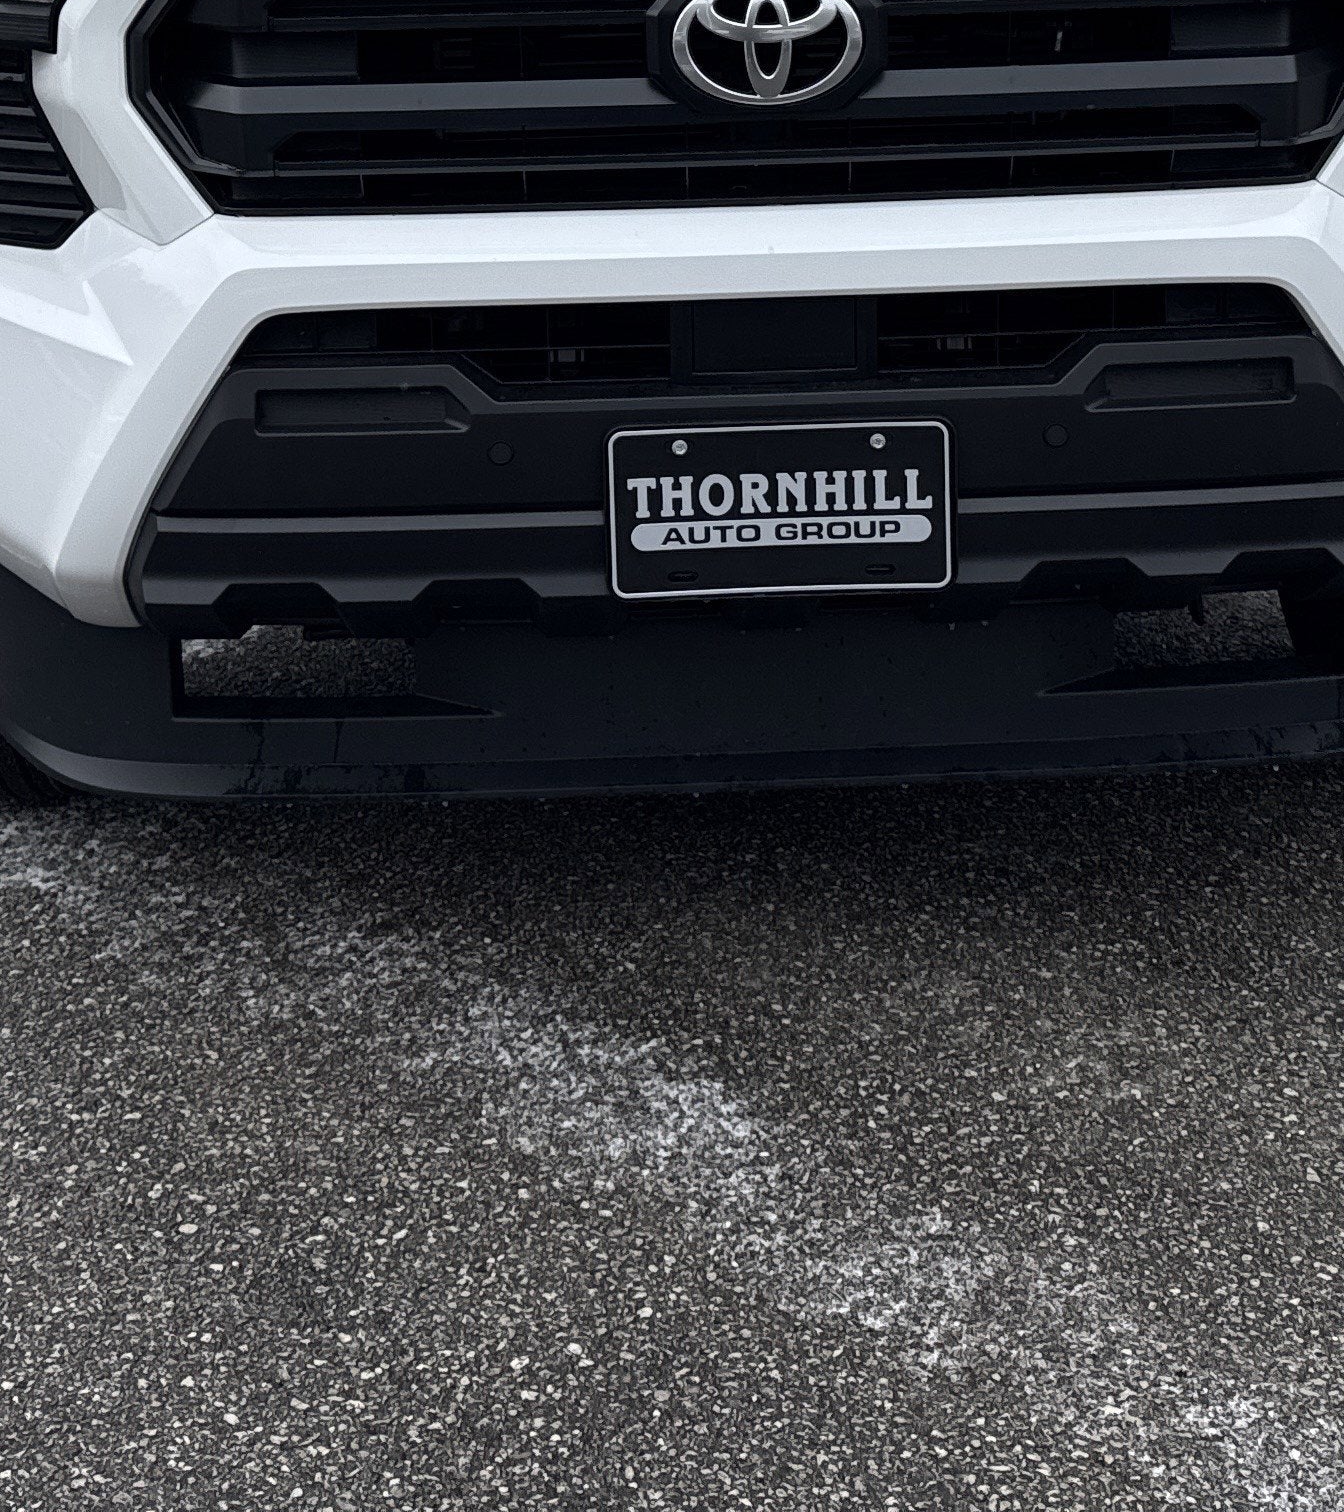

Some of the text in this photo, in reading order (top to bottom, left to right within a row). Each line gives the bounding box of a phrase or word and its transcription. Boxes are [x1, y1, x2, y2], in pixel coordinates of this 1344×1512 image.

[626, 468, 933, 519] THORNHILL
[660, 520, 902, 546] AUTO GROUP
